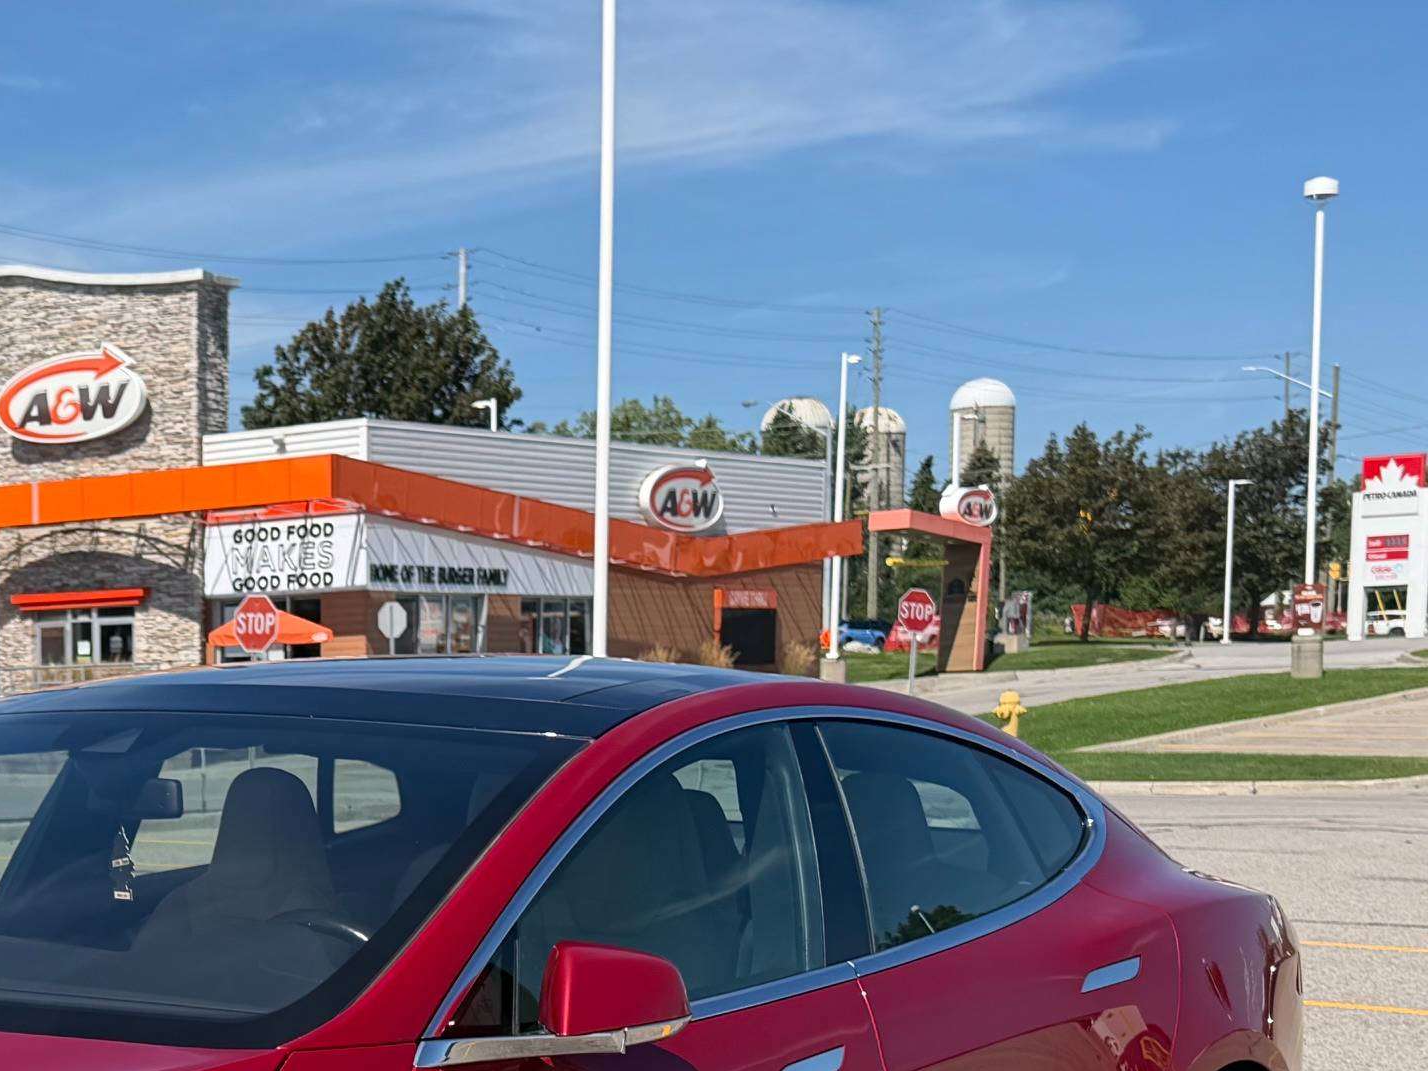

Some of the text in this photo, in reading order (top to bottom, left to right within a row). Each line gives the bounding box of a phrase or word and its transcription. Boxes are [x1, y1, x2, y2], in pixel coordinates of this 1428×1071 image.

[18, 379, 130, 429] A&W
[659, 488, 718, 518] A&W
[963, 501, 993, 519] A&W
[233, 523, 334, 544] GOOD FOOD
[231, 540, 334, 575] MAKES
[232, 572, 334, 592] GOOD FOOD
[370, 563, 398, 583] HOME
[401, 564, 414, 584] OF
[417, 564, 435, 584] THE
[476, 567, 509, 586] FAMILY
[900, 602, 933, 621] STOP
[236, 612, 275, 635] STOP
